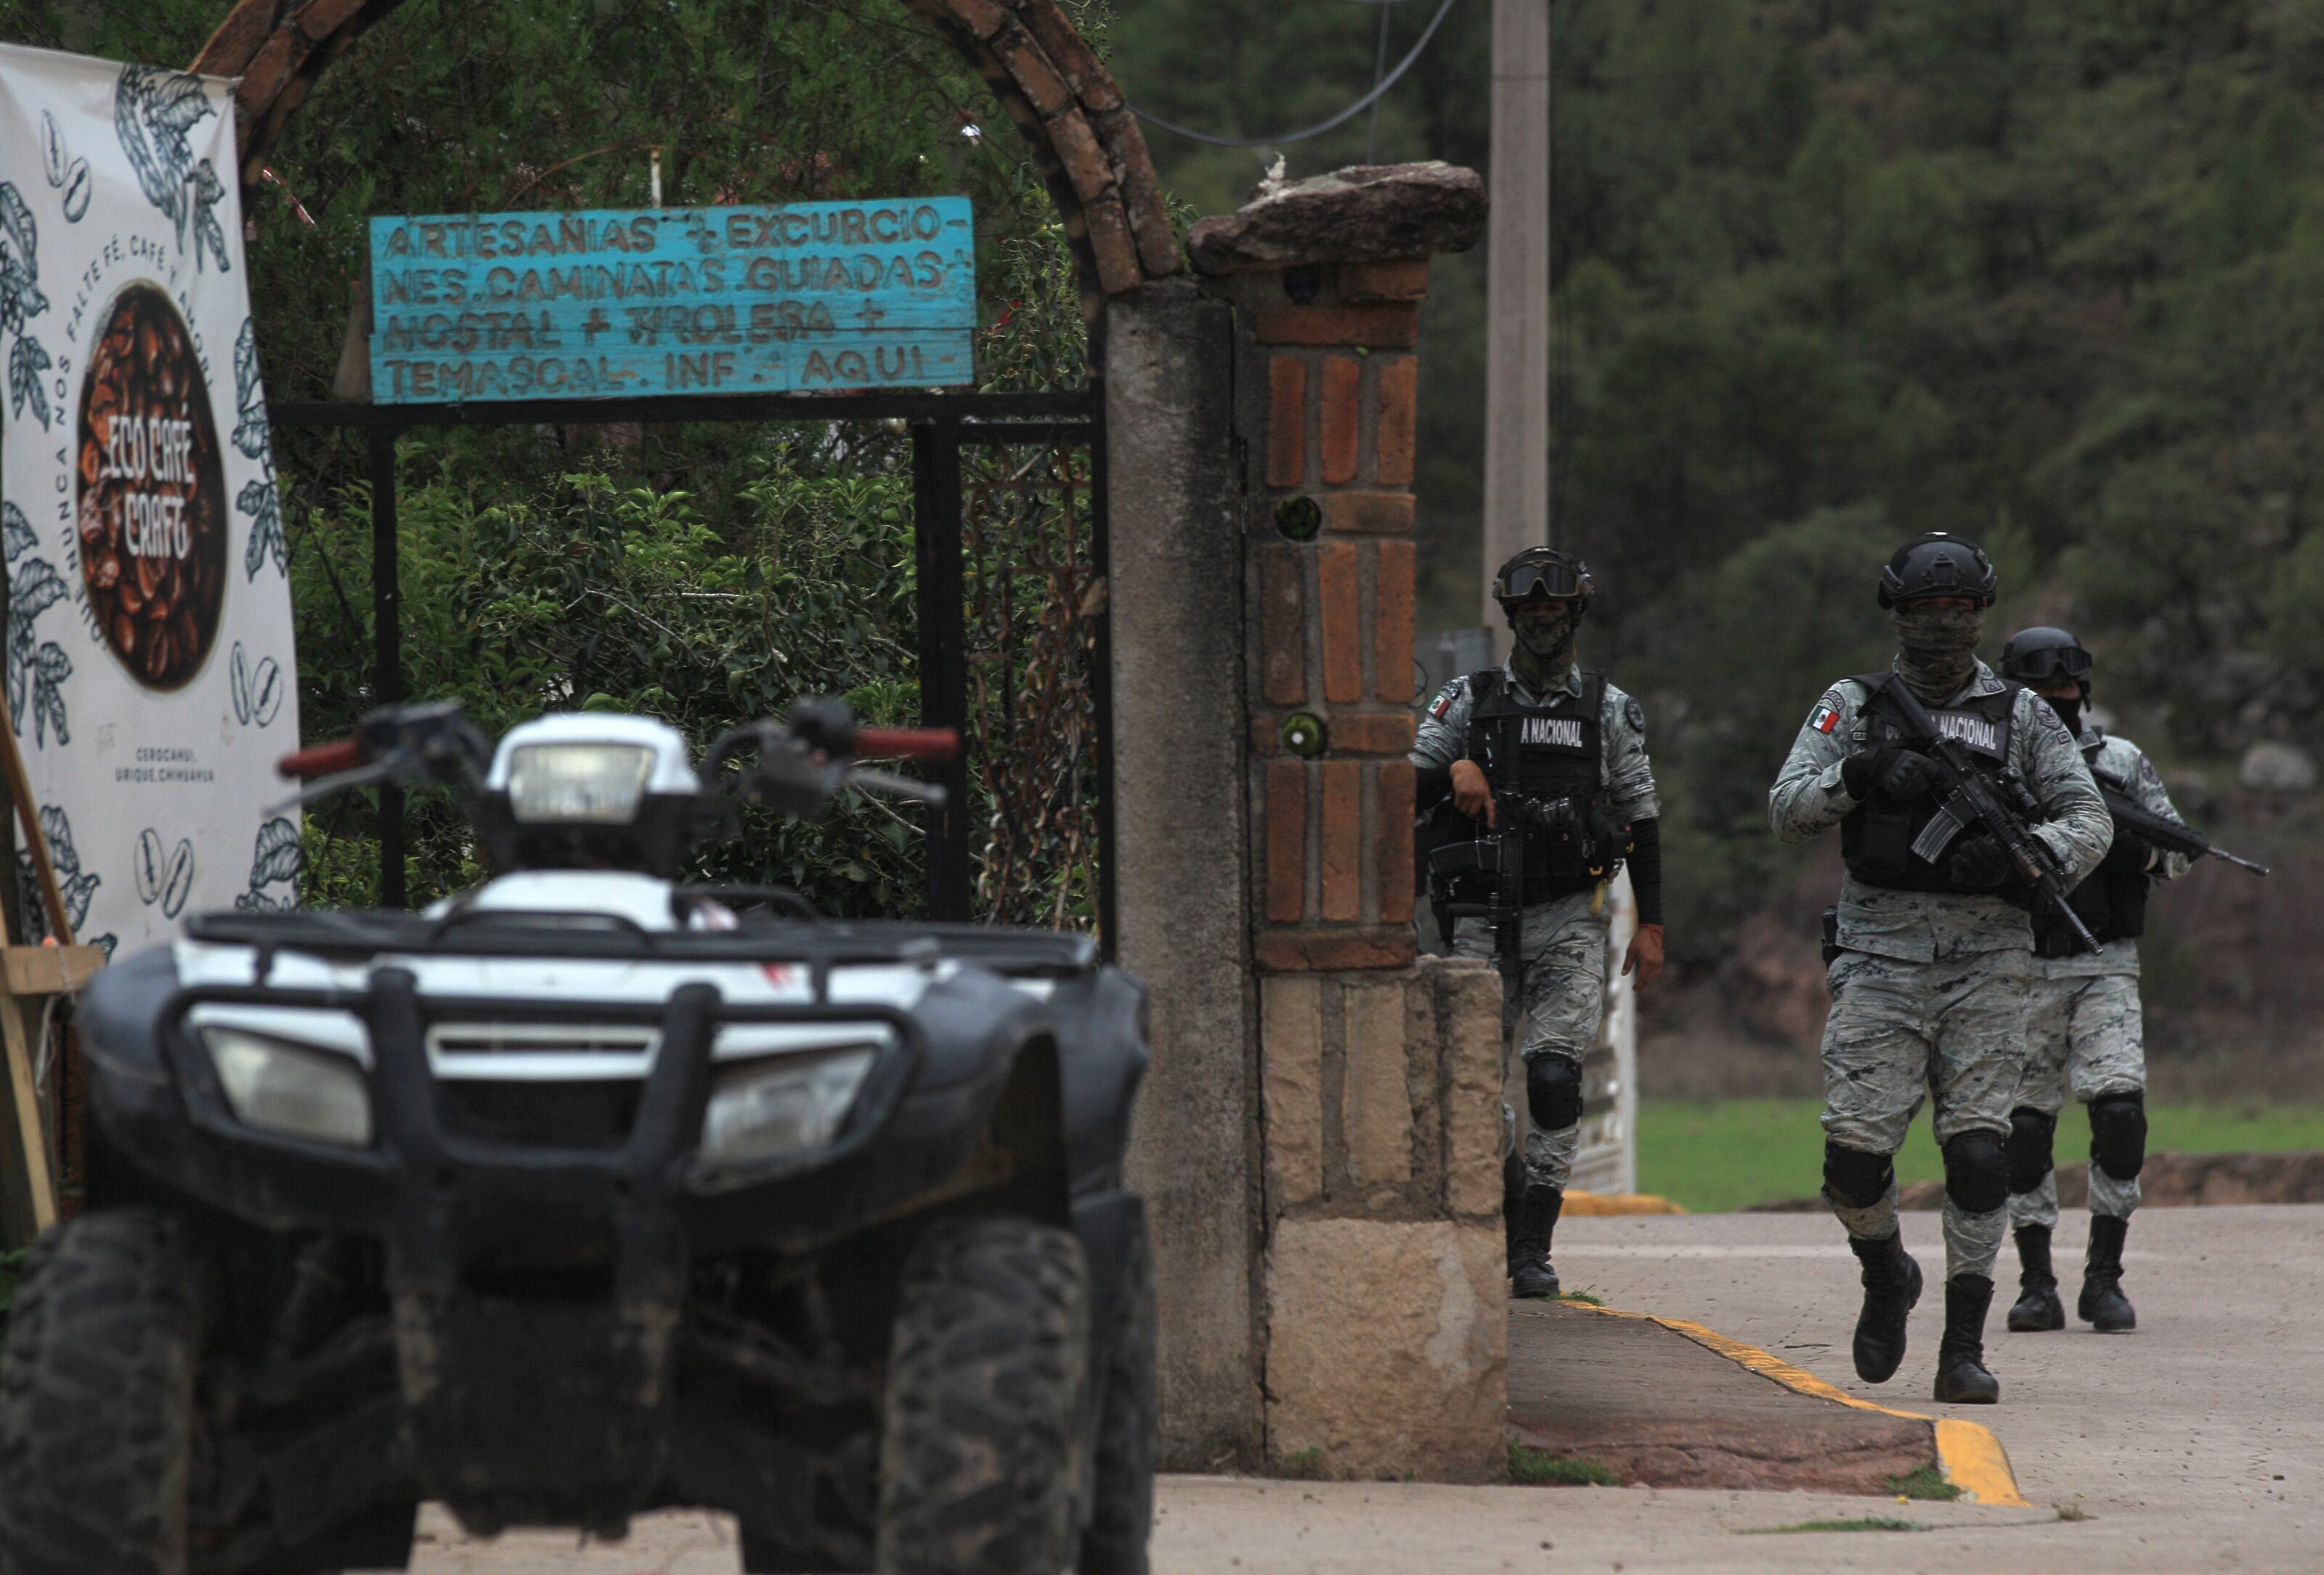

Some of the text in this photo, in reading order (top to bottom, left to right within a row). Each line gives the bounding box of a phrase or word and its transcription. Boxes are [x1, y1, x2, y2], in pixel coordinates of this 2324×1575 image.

[130, 234, 165, 271] CAFÉ
[67, 259, 100, 343] FALTE
[383, 310, 561, 352] HOSTAL
[55, 355, 70, 426] NOS
[803, 345, 924, 384] AQUI
[107, 402, 195, 484] ECO CAFÉ
[56, 447, 78, 571] NUNCA
[124, 492, 191, 560] CRAFT
[1531, 717, 1582, 747] NACIONAL
[1940, 715, 1996, 750] NACIONAL
